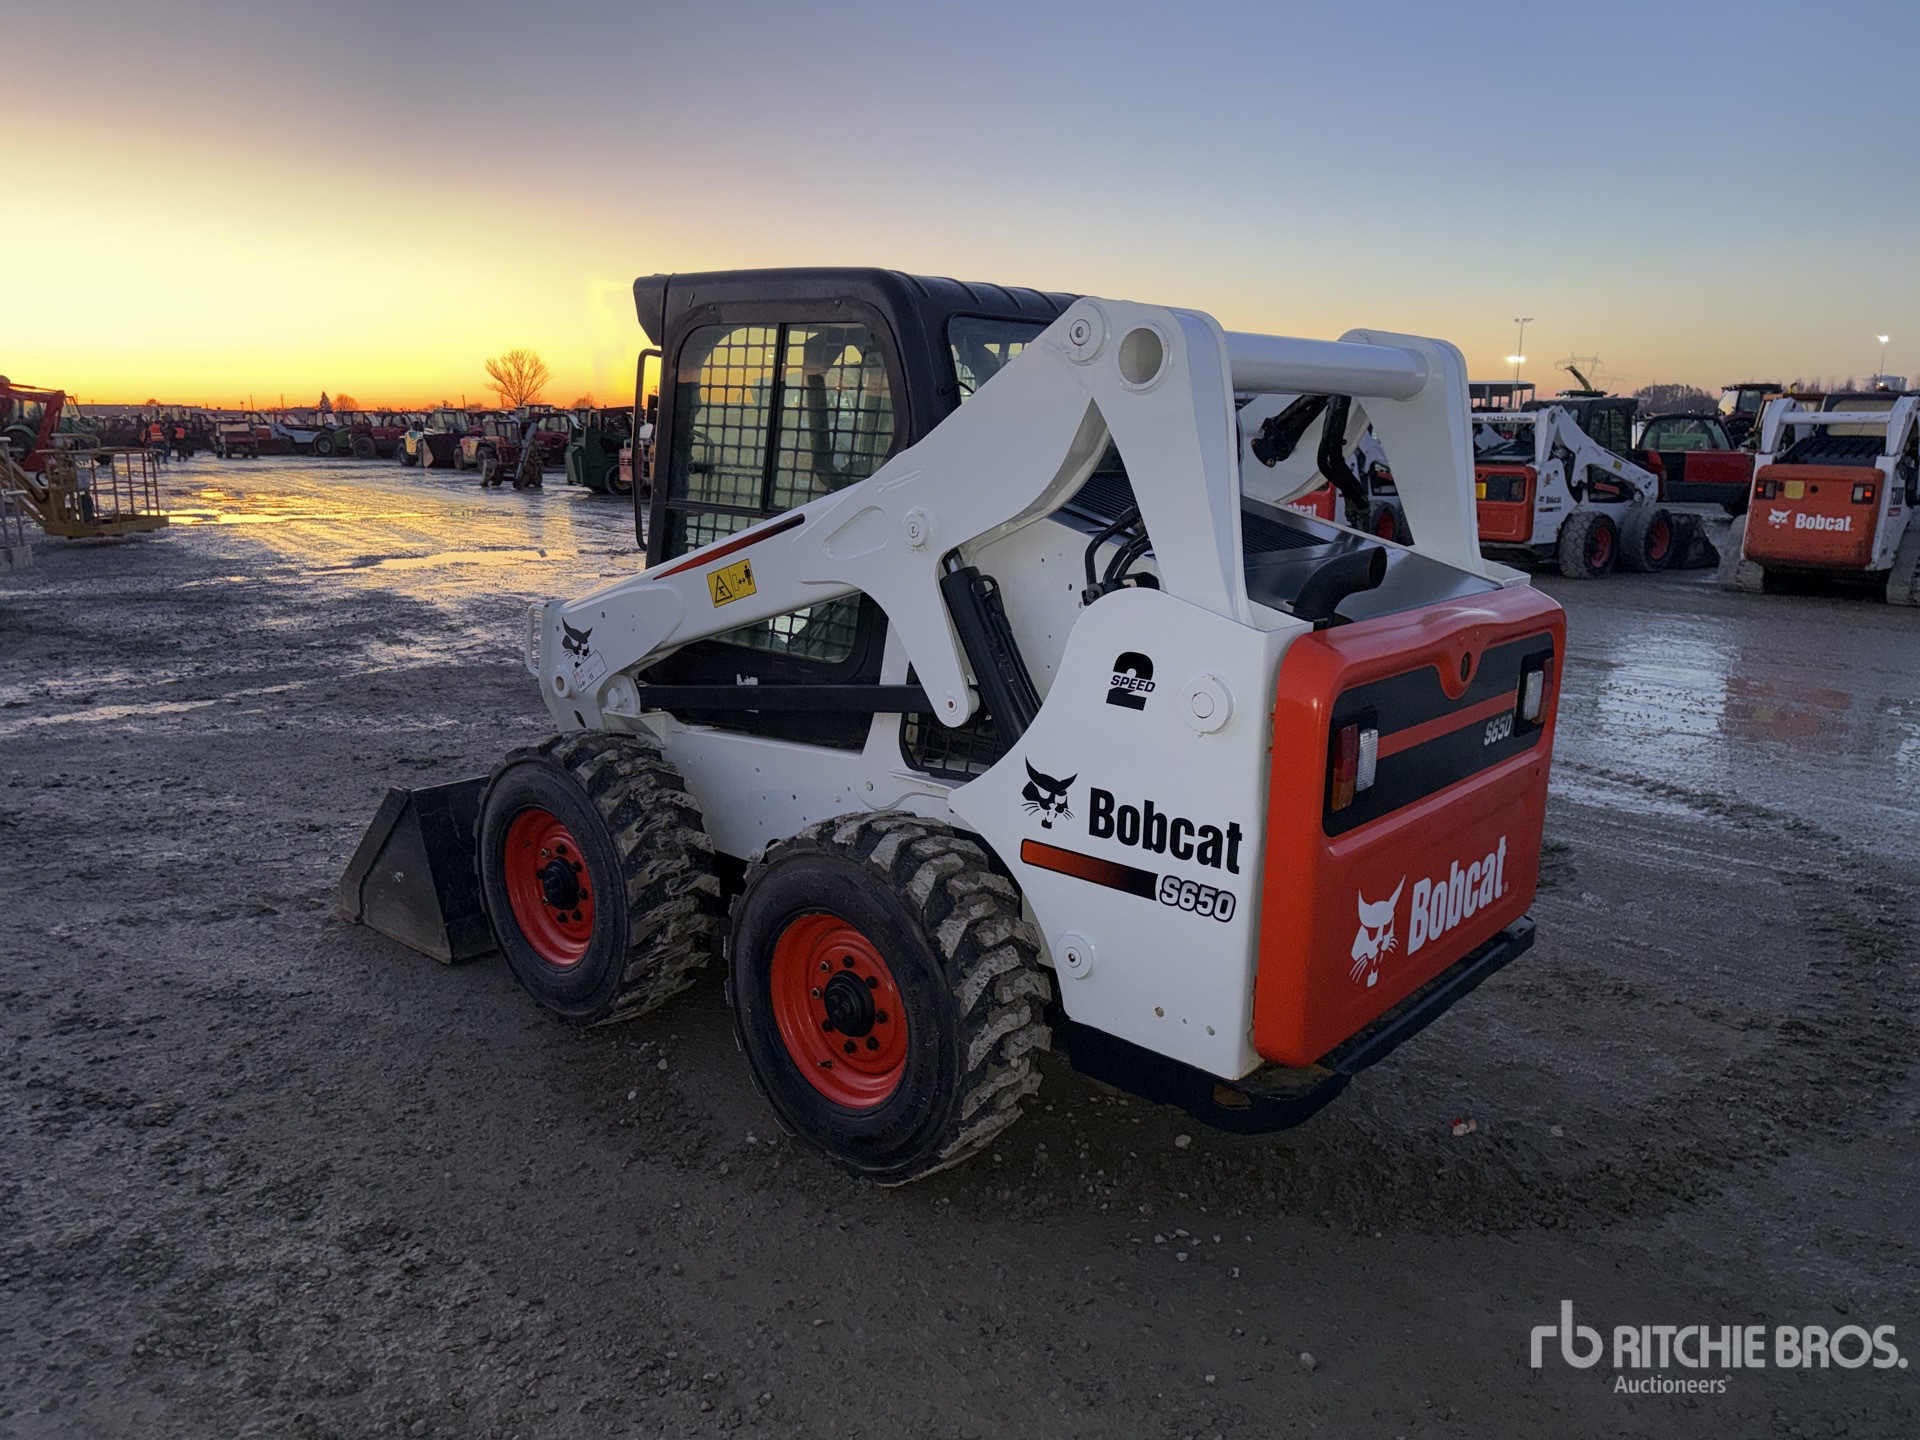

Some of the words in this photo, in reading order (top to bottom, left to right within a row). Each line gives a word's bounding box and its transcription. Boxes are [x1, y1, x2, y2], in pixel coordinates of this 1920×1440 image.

[1286, 502, 1317, 516] bcat
[1795, 512, 1852, 532] Bobcat
[1106, 651, 1154, 711] 2
[1110, 675, 1156, 692] SPEED
[1483, 713, 1513, 746] S650
[1088, 787, 1243, 875] Bobcat
[1159, 875, 1237, 923] S650
